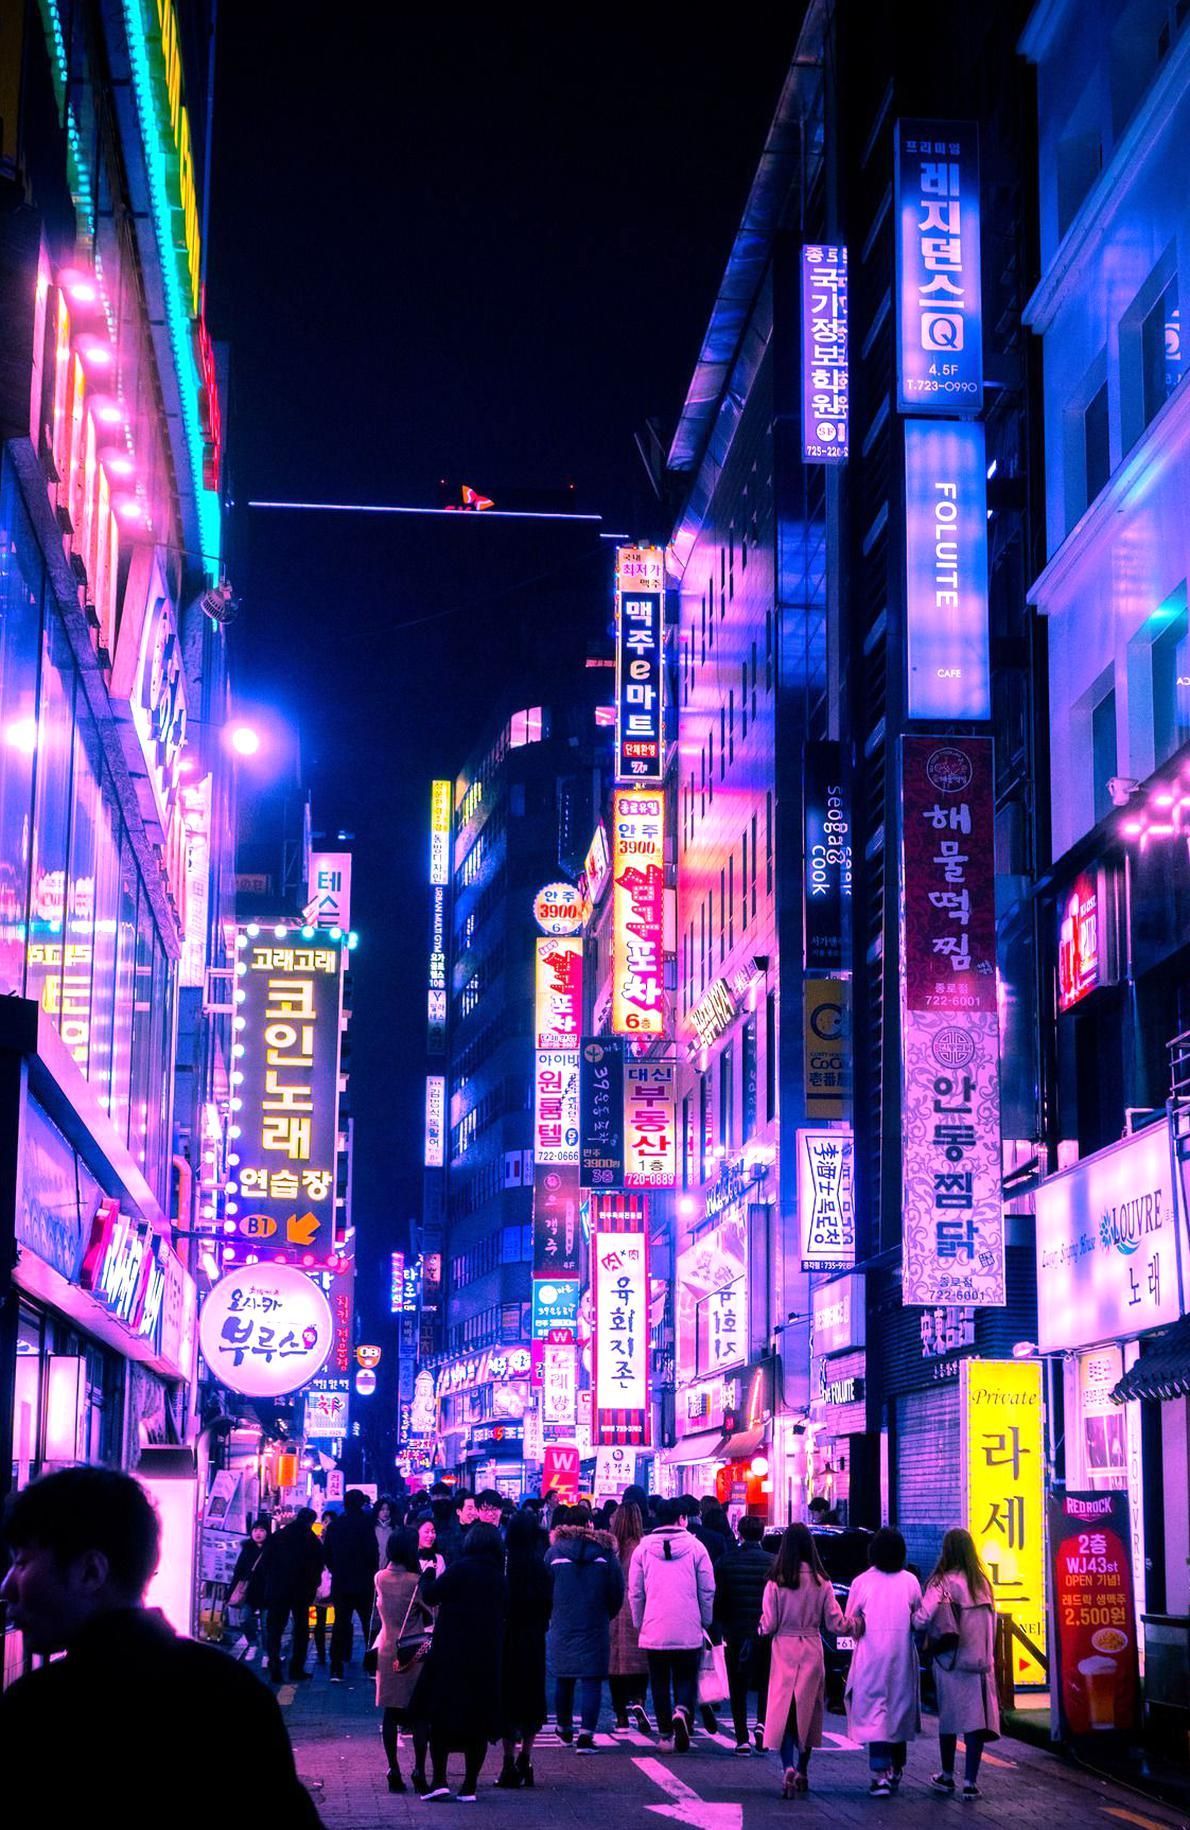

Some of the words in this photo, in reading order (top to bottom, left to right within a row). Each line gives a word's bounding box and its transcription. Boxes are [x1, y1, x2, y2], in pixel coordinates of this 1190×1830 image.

[919, 162, 965, 309] 레지던스
[810, 267, 838, 419] 국가정보학원
[927, 317, 958, 350] Q
[934, 482, 959, 608] FOLUITE
[623, 563, 660, 577] 최저가
[626, 601, 656, 736] 맥주e마트
[937, 669, 962, 679] CAFE
[618, 824, 659, 839] 안주
[545, 891, 575, 903] 안주
[922, 803, 973, 972] 해물떡찜
[251, 948, 336, 974] 고래고래
[262, 979, 317, 1160] 코인노래
[628, 1068, 671, 1082] 대신
[538, 1071, 563, 1147] 원룸텔
[630, 1085, 671, 1157] 부동산
[627, 1173, 674, 1186] 720-0889
[639, 1160, 664, 1172] 1층
[933, 1076, 979, 1260] 안동찜닭
[239, 1167, 333, 1200] 연습장
[248, 1217, 270, 1234] B1
[1112, 1189, 1162, 1245] LOUVRE
[1129, 1252, 1160, 1306] 노래
[219, 1316, 308, 1367] 부루스
[552, 1332, 568, 1342] W
[610, 1276, 635, 1389] 육회지존
[551, 1353, 570, 1411] 노래방
[971, 1388, 1037, 1408] Private
[552, 1453, 574, 1471] W
[981, 1426, 1031, 1602] 라세느
[1079, 1534, 1107, 1555] 2층
[1066, 1557, 1118, 1574] WJ43st
[1066, 1575, 1092, 1587] OPEN
[1097, 1574, 1121, 1587] 기념!
[1062, 1594, 1092, 1606] 레드락
[1096, 1593, 1127, 1606] 생맥주
[1065, 1608, 1126, 1626] 2,500원
